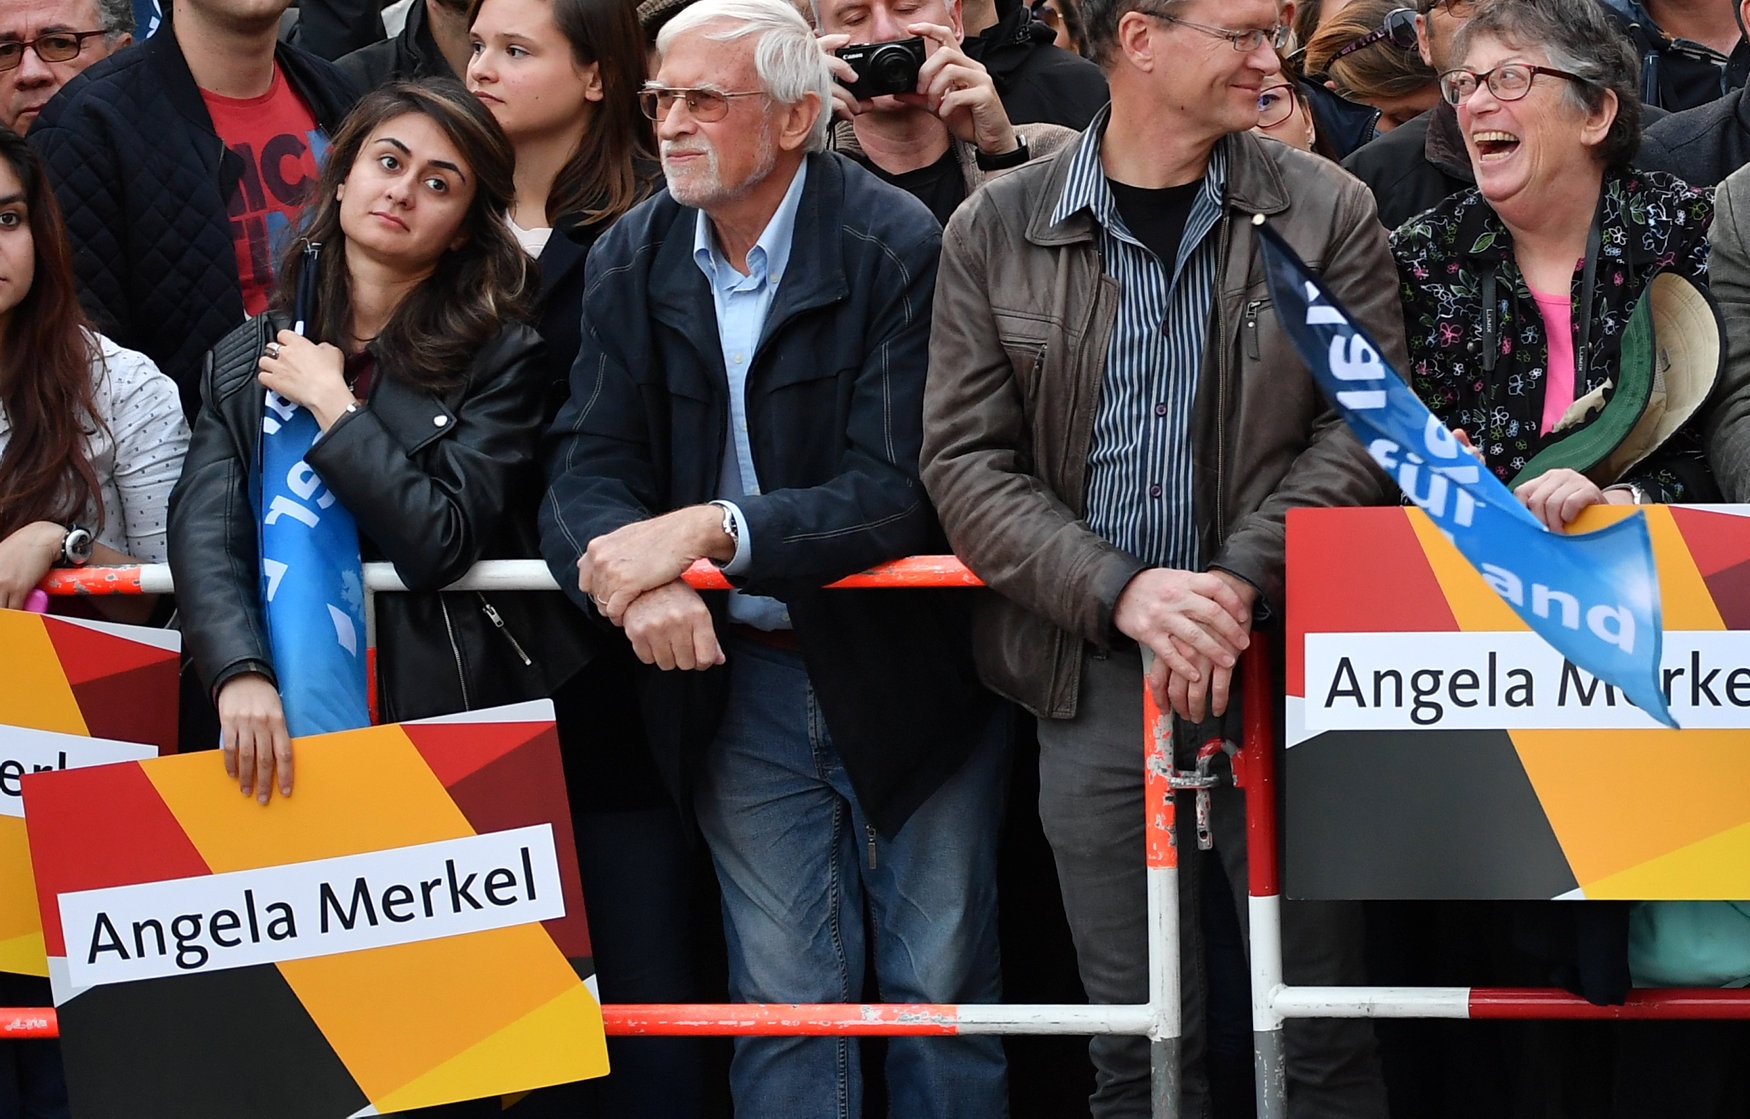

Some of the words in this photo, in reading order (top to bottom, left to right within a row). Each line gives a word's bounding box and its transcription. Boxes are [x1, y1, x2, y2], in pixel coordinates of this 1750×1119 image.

[1324, 650, 1534, 723] Angela
[86, 888, 298, 969] Angela
[319, 846, 538, 934] Merkel
